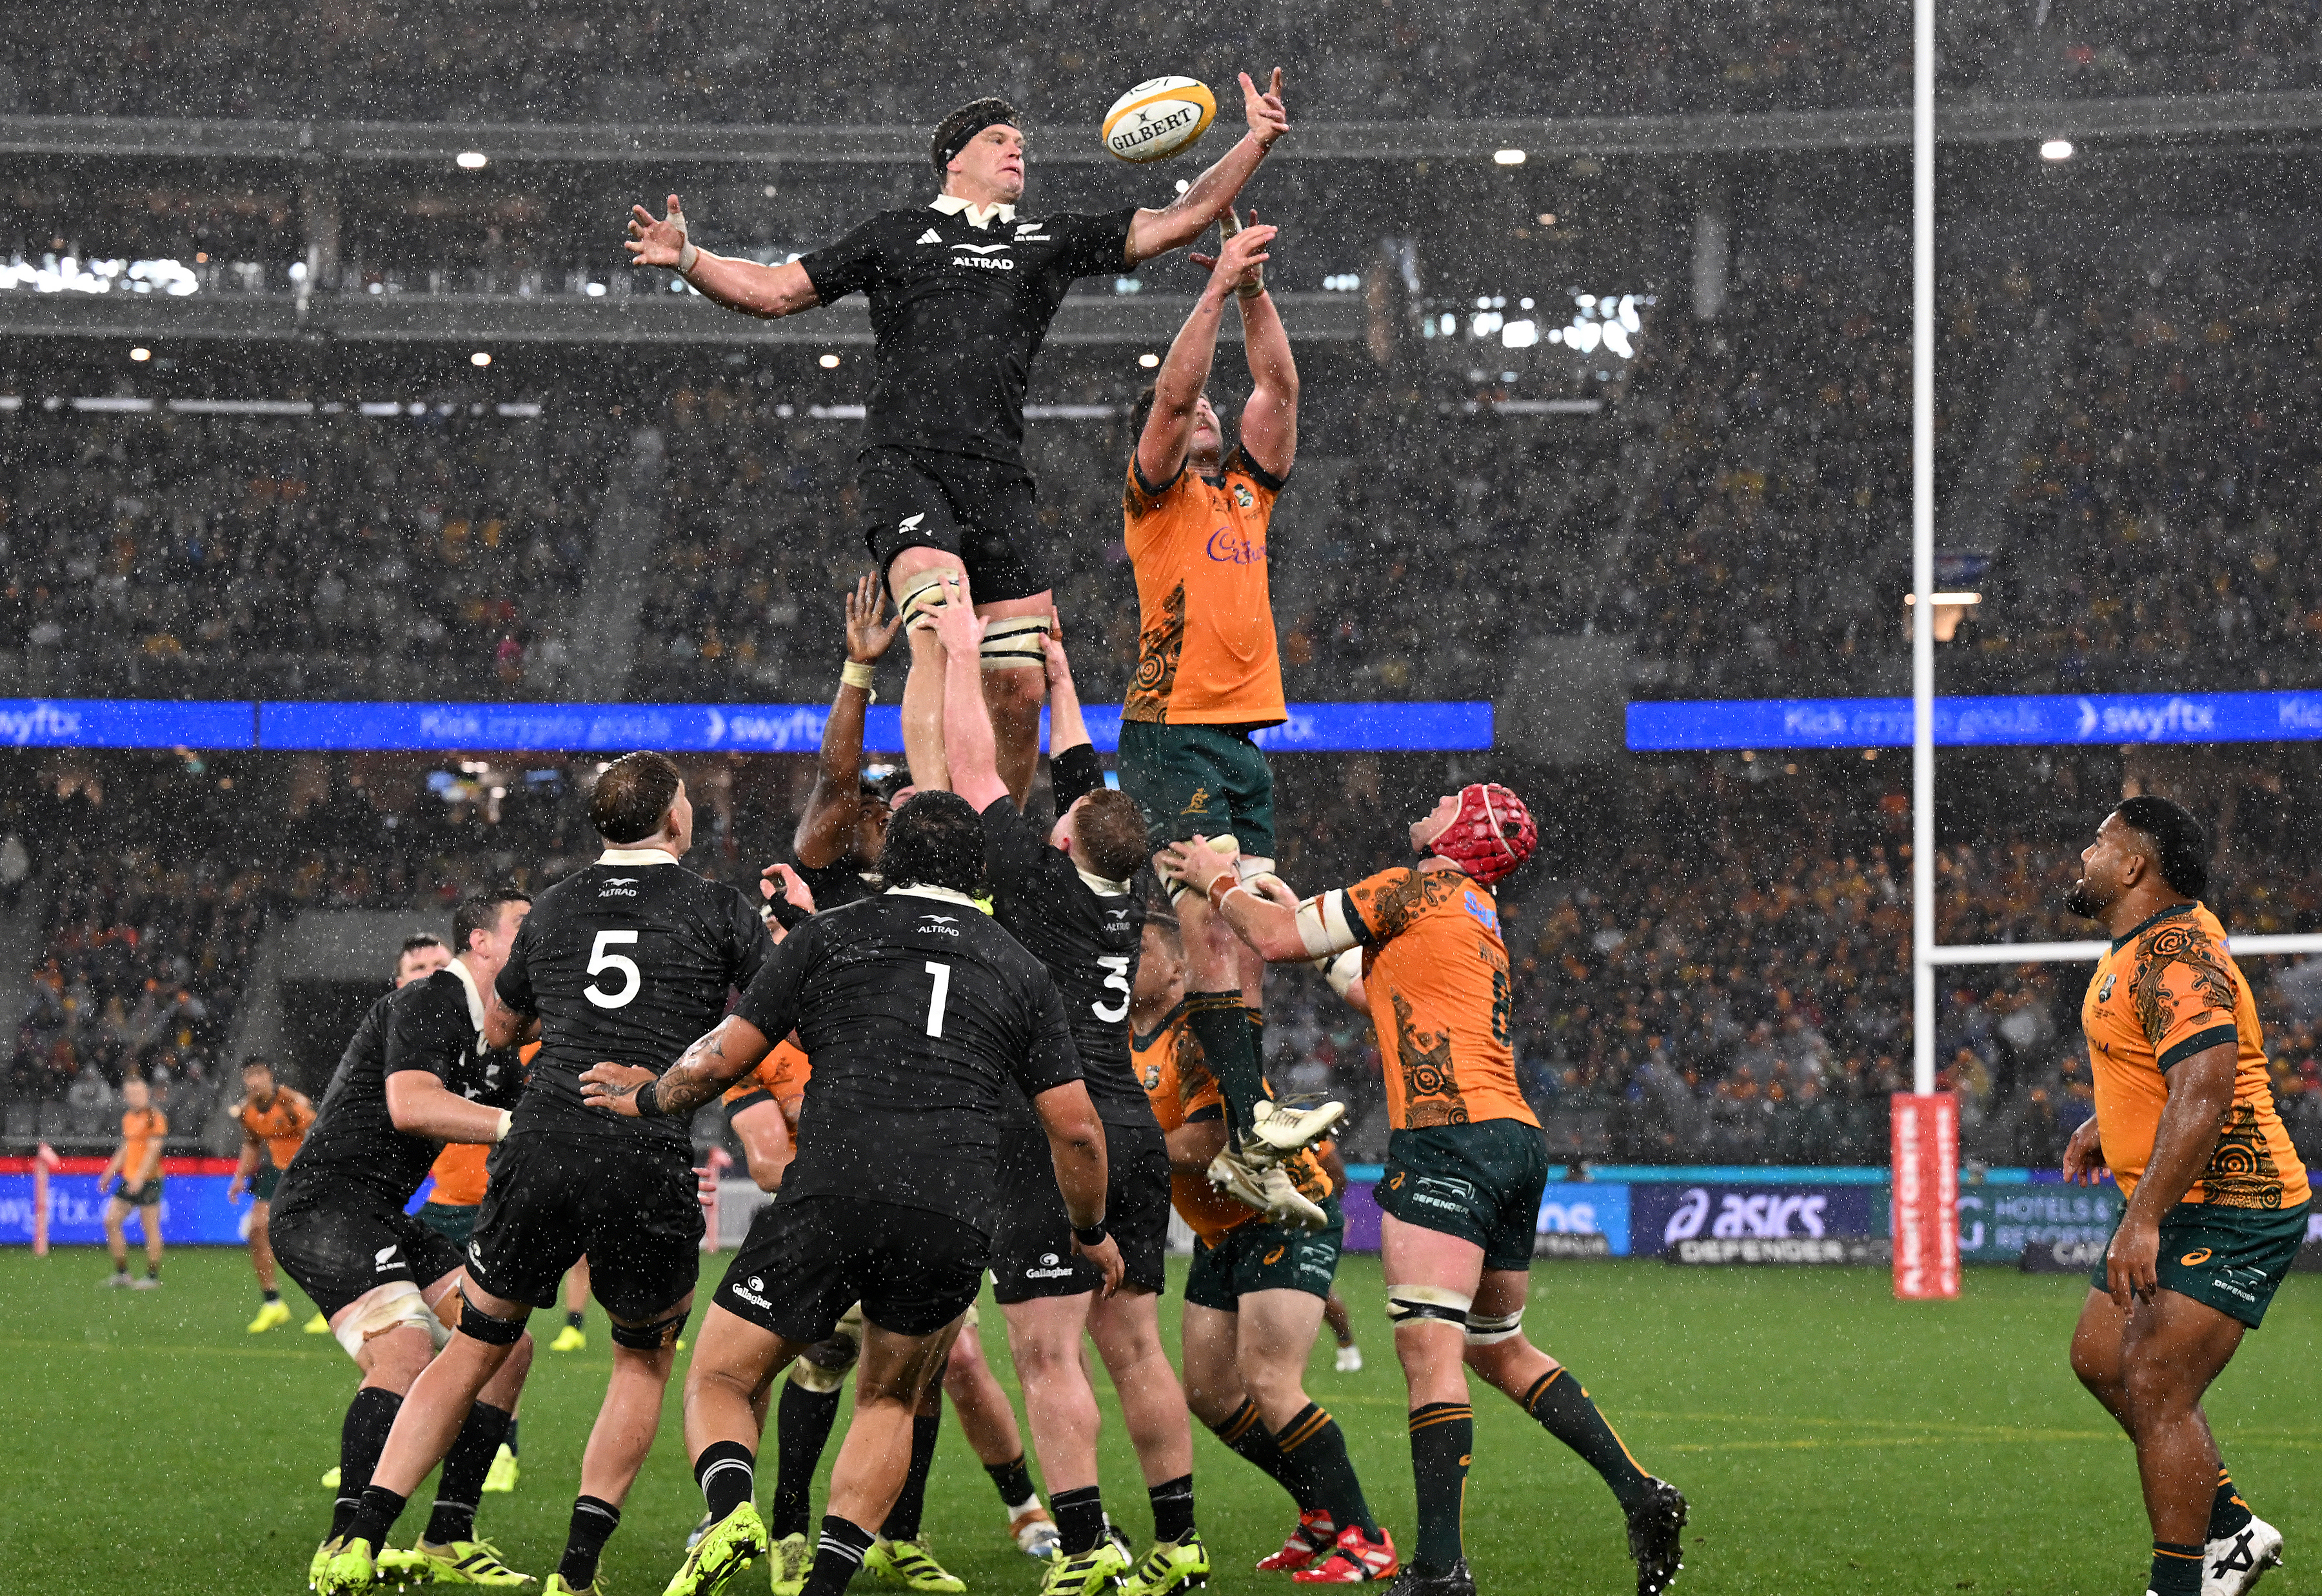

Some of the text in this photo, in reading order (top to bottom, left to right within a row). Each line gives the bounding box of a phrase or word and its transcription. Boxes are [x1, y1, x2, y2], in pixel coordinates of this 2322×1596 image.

[1112, 108, 1191, 150] GILBERT
[952, 257, 1014, 270] ALTRAD
[730, 709, 826, 750] swyft
[1852, 709, 1954, 745] crypo
[598, 888, 637, 898] ALTRAD
[917, 925, 959, 936] ALTRAD
[583, 931, 640, 1009] 5
[925, 961, 951, 1038] 1
[1091, 956, 1131, 1023] 3
[1413, 1193, 1470, 1214] DEFENDER
[1994, 1197, 2090, 1222] HOTELS
[1679, 1239, 1843, 1264] DEFENDER
[1027, 1266, 1073, 1279] Gallagher
[732, 1283, 772, 1310] Gallagher
[2214, 1279, 2256, 1303] DEFENDER
